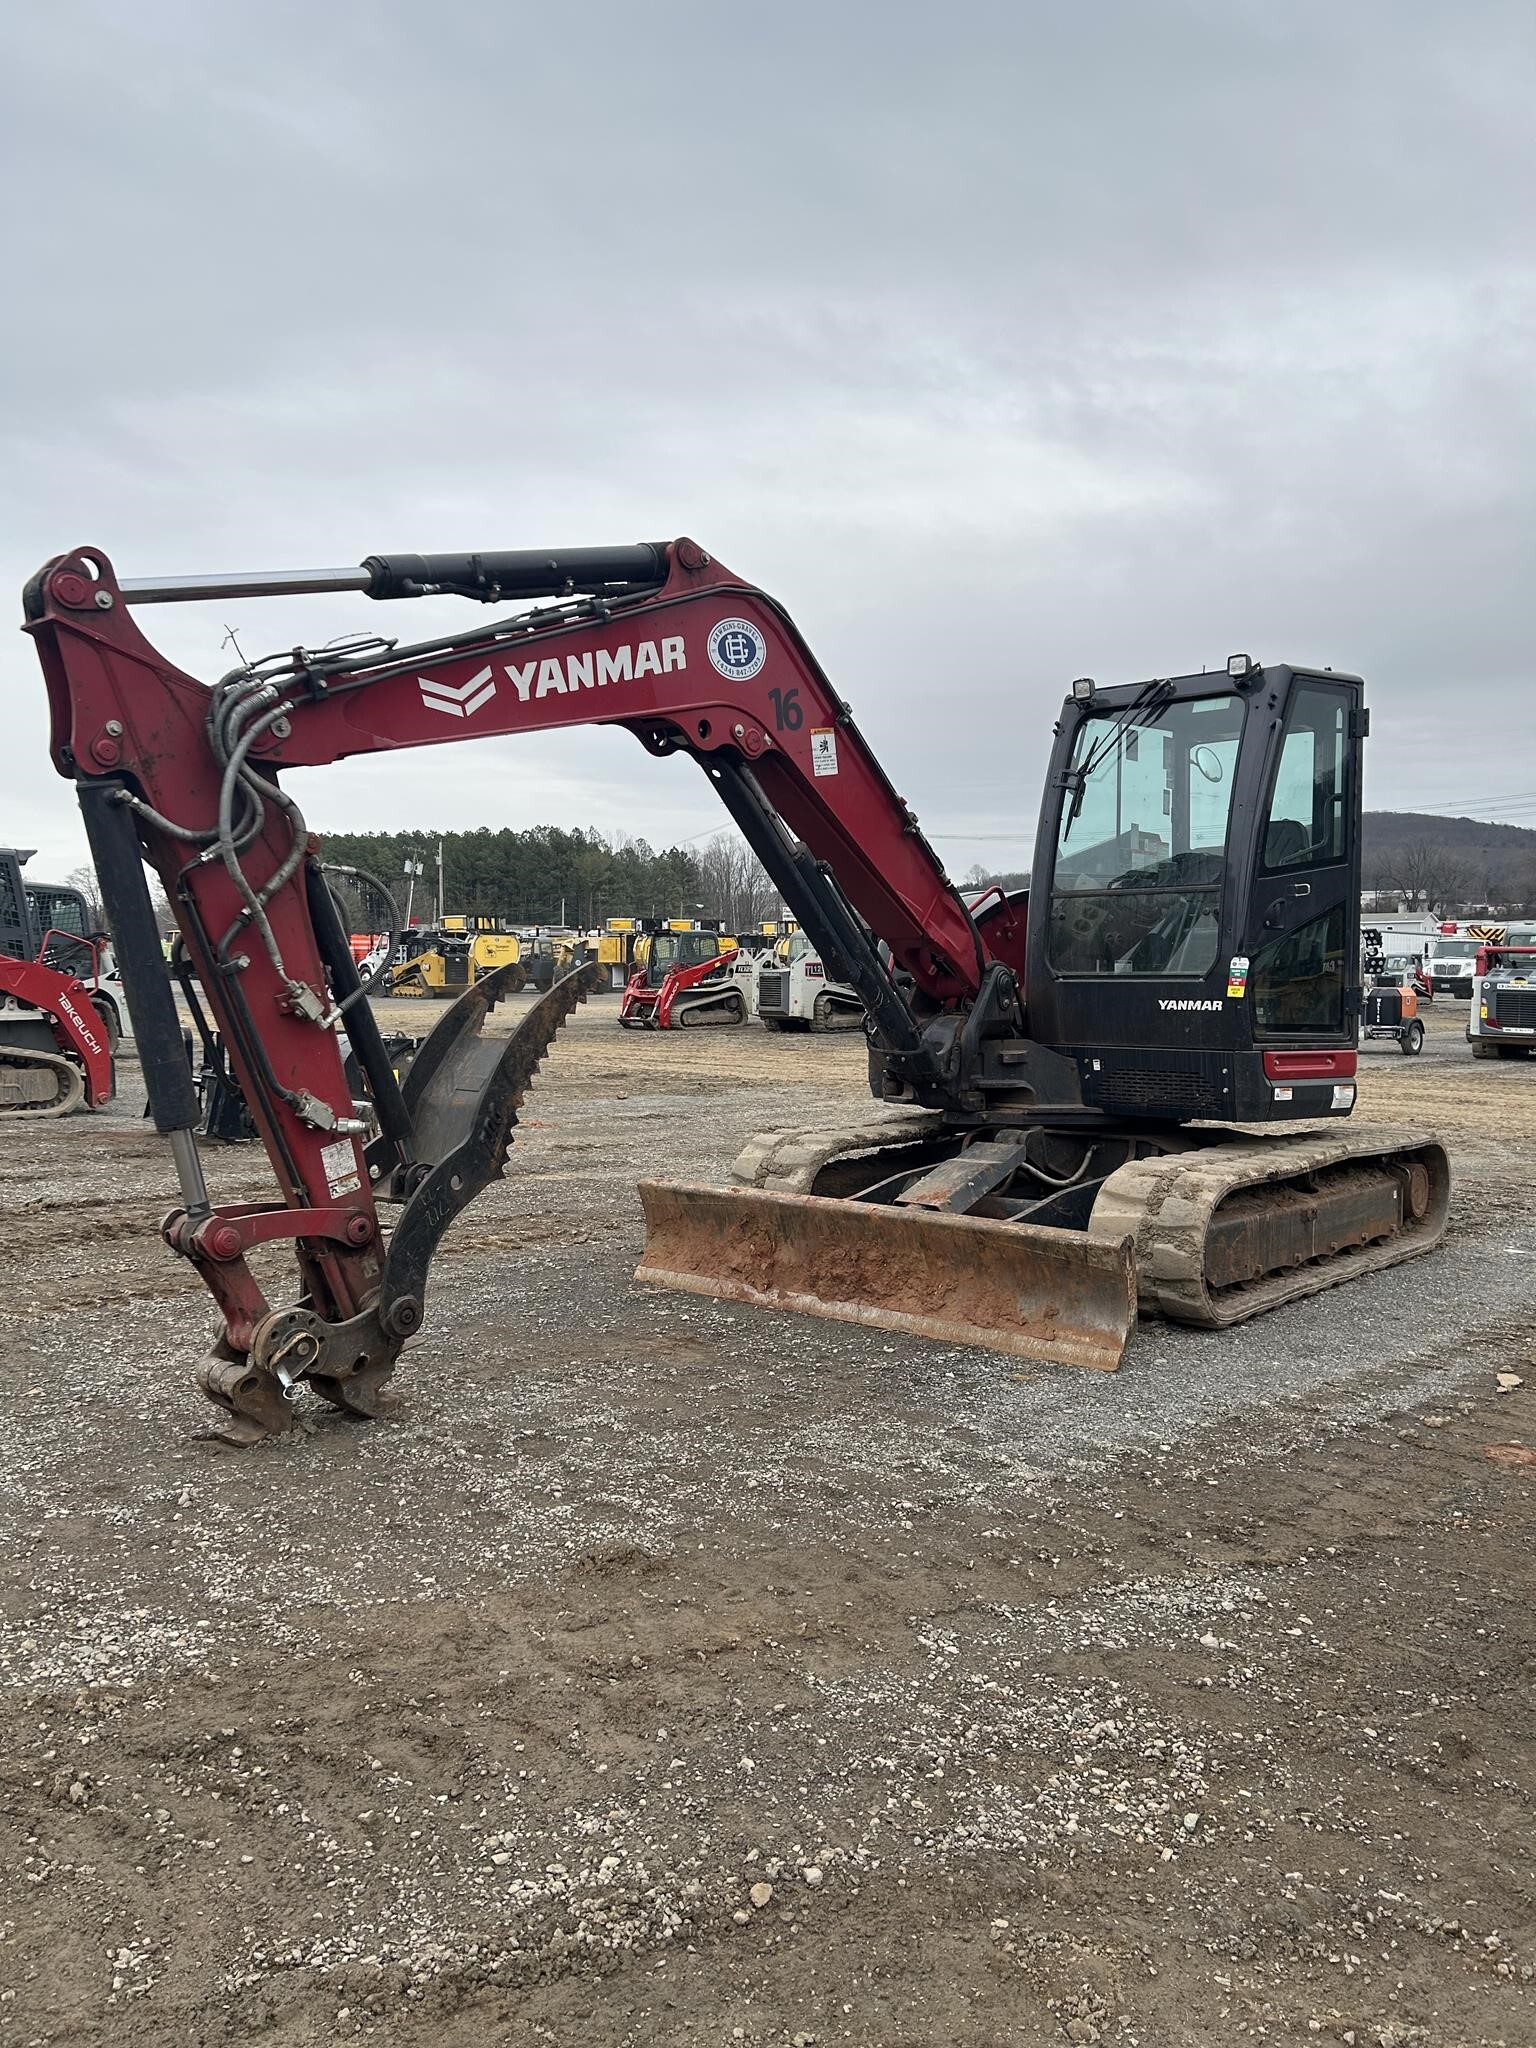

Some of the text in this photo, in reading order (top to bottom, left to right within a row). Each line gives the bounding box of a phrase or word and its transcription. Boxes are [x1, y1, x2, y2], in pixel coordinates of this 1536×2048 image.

[504, 635, 687, 702] YANMAR
[768, 687, 804, 732] 16
[1158, 999, 1223, 1011] YANMAR
